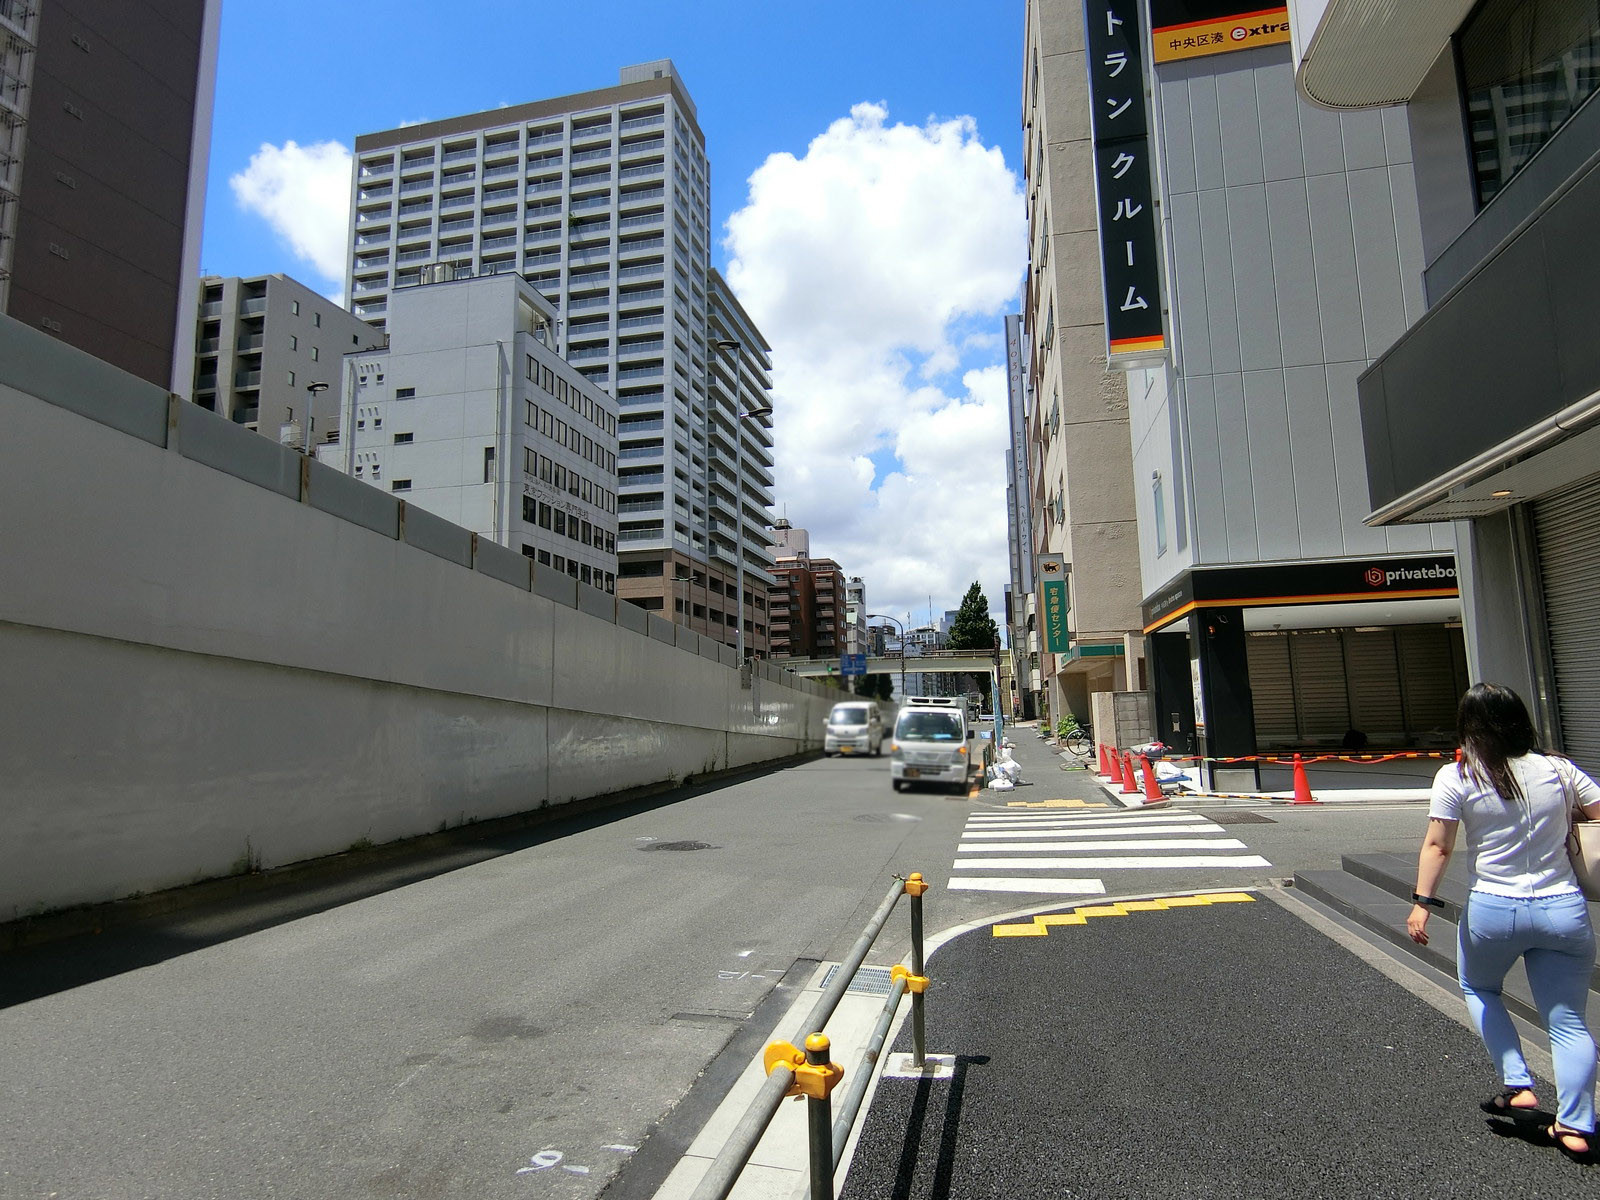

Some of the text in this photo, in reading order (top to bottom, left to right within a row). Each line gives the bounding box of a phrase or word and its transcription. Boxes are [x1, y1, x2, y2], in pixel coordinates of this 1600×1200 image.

[1169, 31, 1224, 51] 中央区湊
[1104, 10, 1149, 313] トランクルーム
[1385, 563, 1458, 586] privatebo
[1049, 587, 1062, 646] 宅急便センター
